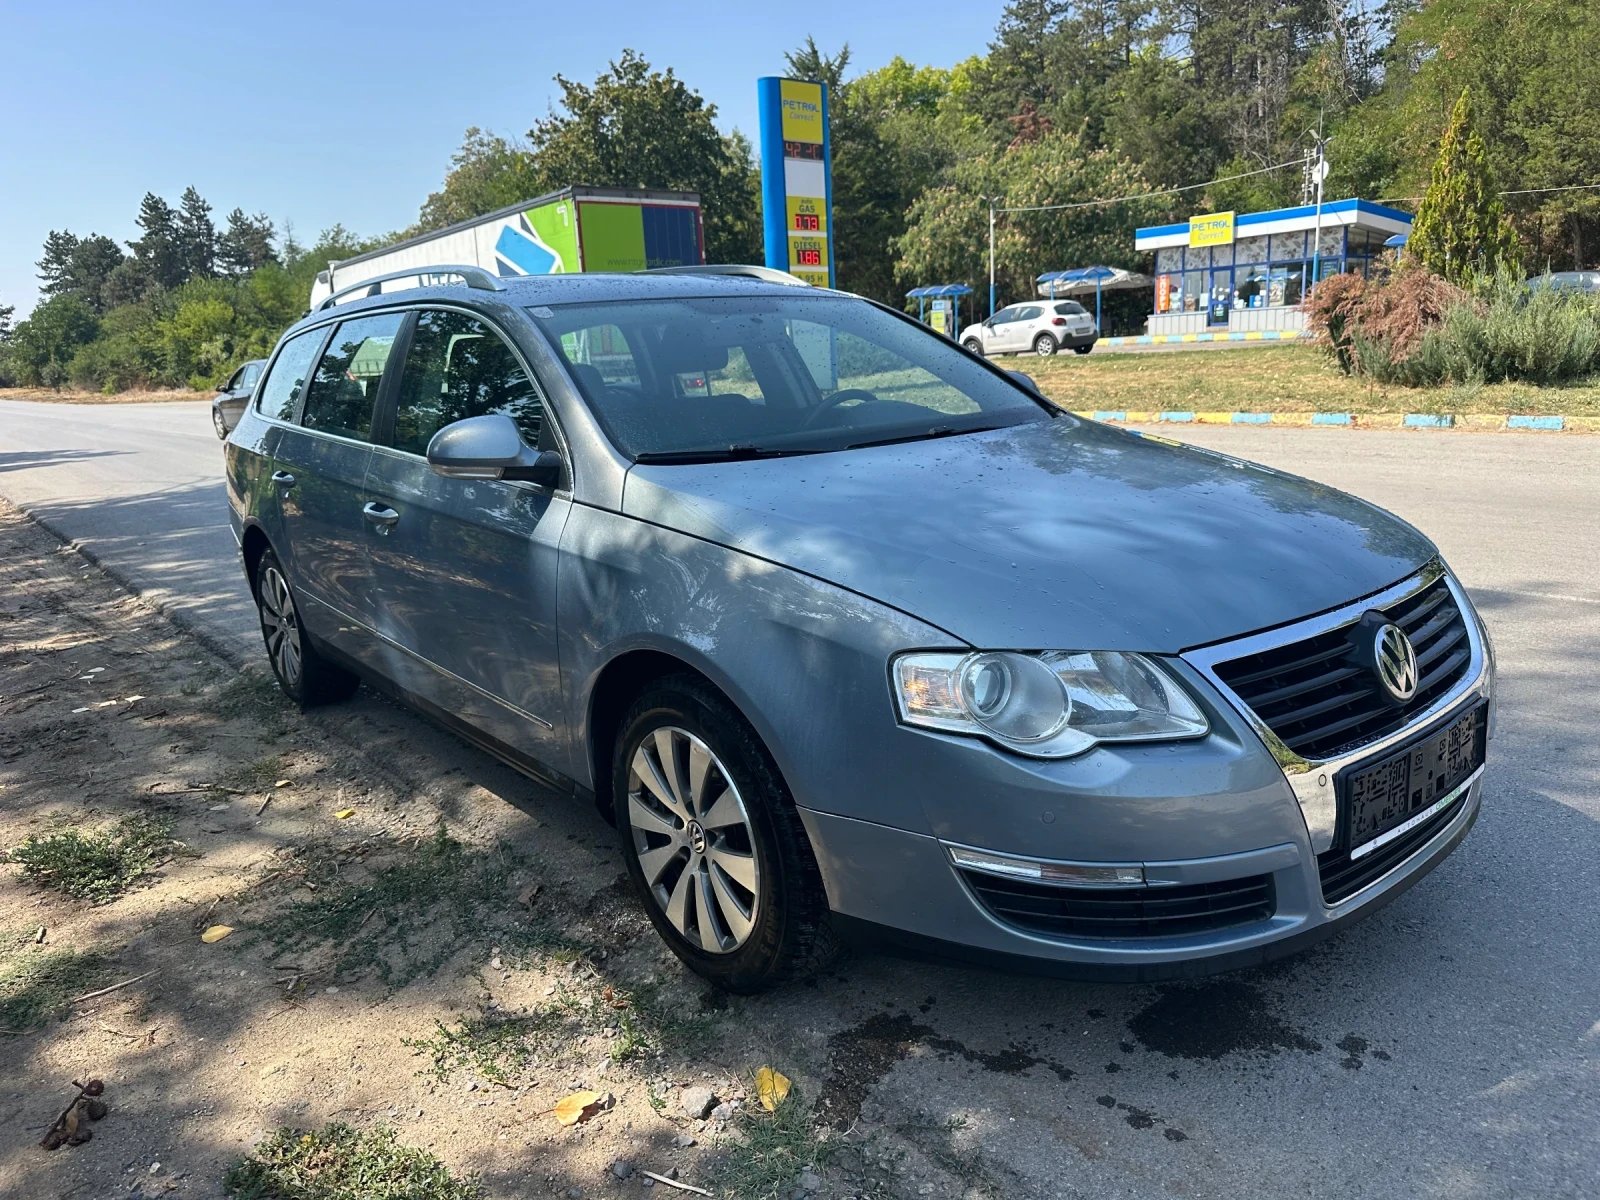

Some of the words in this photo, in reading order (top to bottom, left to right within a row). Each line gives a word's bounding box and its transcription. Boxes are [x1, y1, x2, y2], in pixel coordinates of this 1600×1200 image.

[783, 99, 820, 113] PETROL
[785, 142, 801, 158] 42
[799, 204, 815, 213] GAS
[794, 215, 818, 231] 0.73
[1191, 219, 1230, 232] PETROL
[793, 241, 822, 250] DIESEL
[799, 250, 820, 265] 1.86
[805, 274, 815, 283] 95
[817, 274, 823, 283] H
[1397, 808, 1433, 834] AUTOHAUS
[1435, 786, 1462, 811] GMEINER
